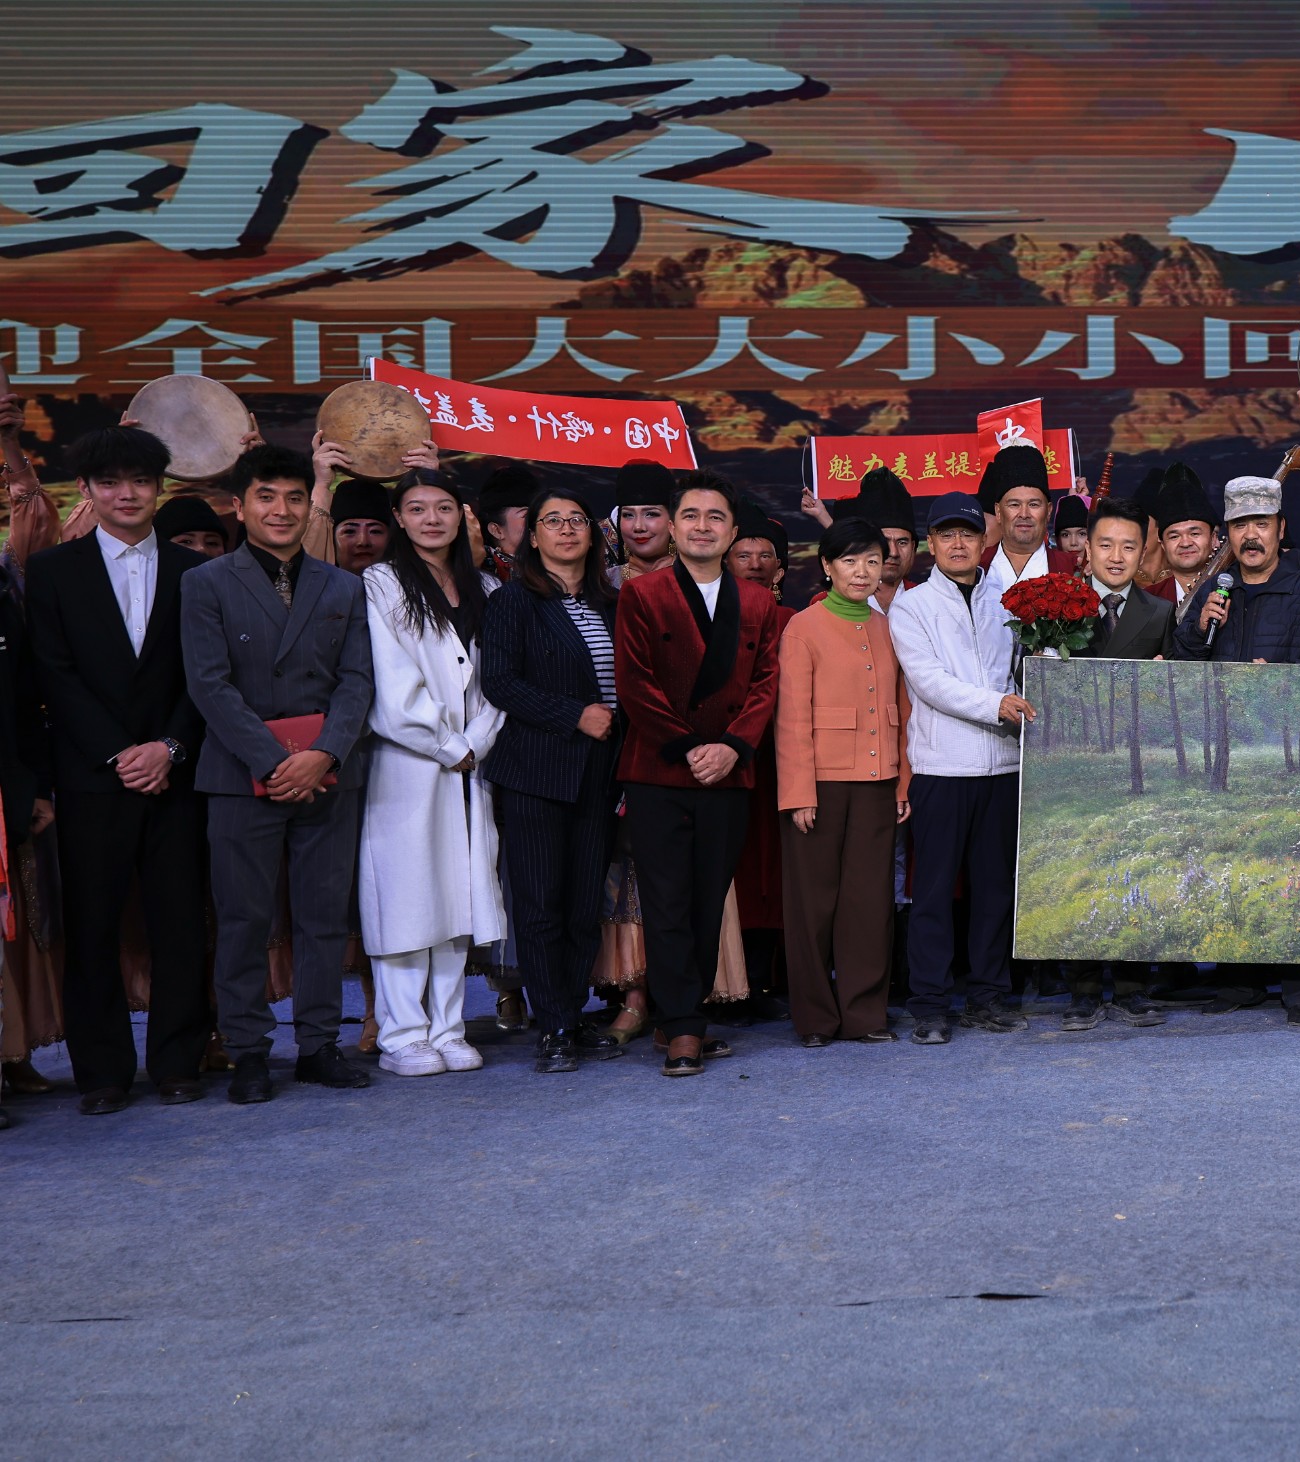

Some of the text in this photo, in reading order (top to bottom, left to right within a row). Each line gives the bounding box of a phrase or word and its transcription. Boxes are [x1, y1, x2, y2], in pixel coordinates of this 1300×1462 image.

[0, 26, 1019, 298] 回家
[827, 444, 1061, 482] 魅力麦盖提您
